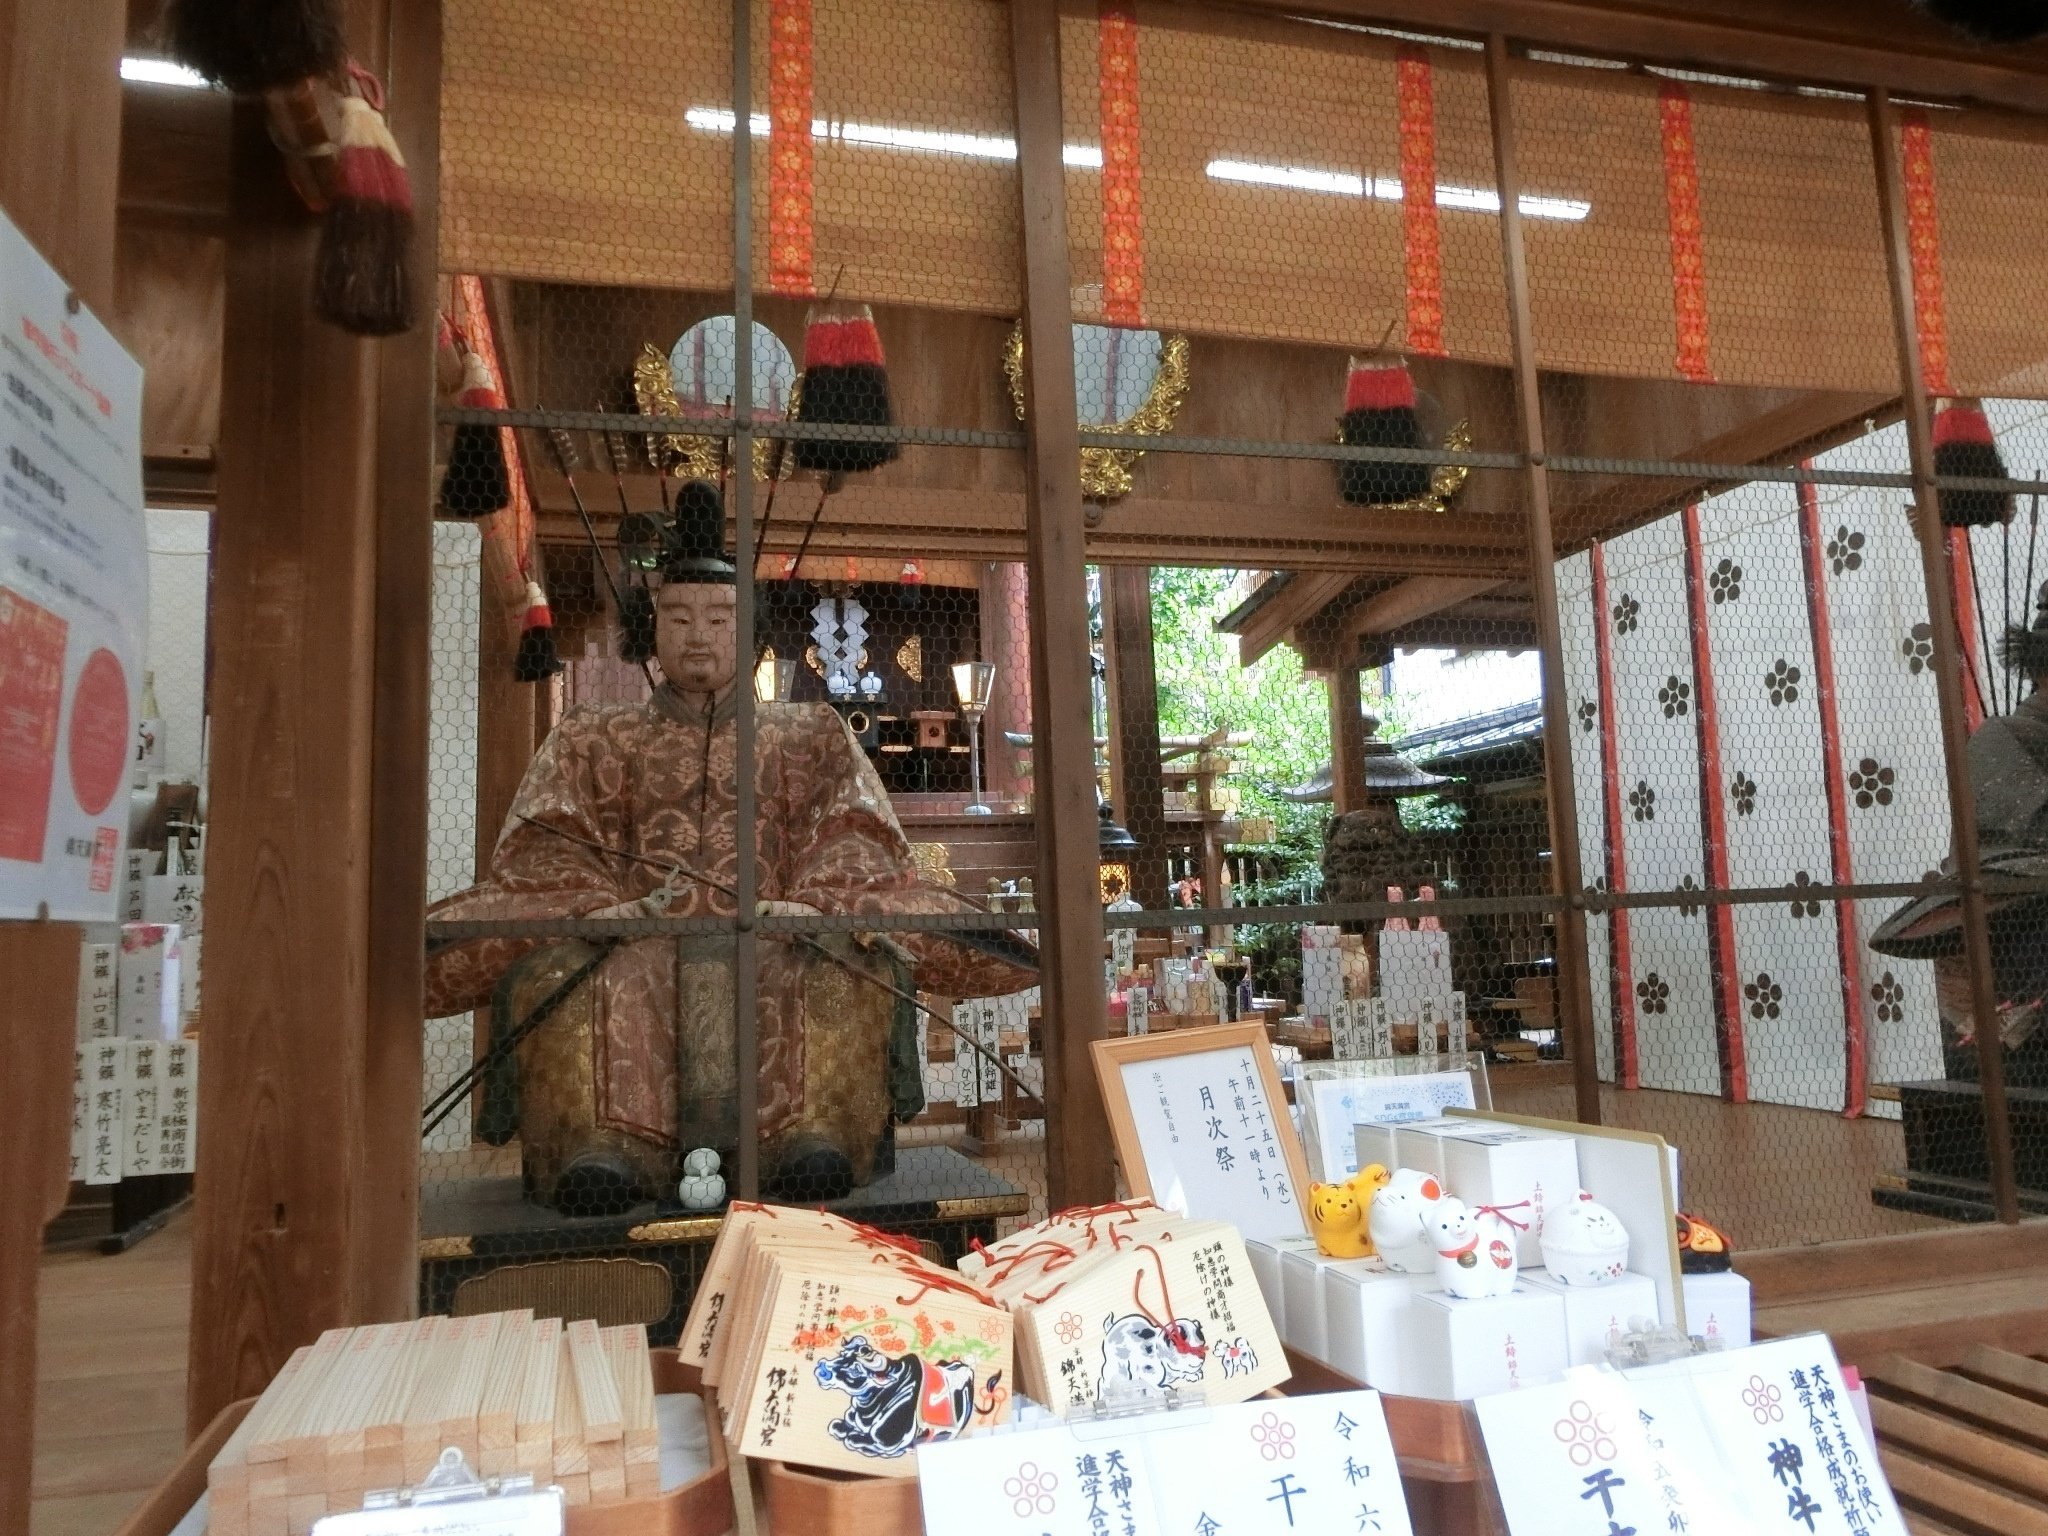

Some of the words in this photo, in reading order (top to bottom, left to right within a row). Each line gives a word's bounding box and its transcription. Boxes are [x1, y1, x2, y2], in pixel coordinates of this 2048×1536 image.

[132, 1088, 153, 1171] やまだしや
[170, 1087, 190, 1170] 新京極商店街
[1198, 1085, 1236, 1172] 月次祭
[1228, 1077, 1270, 1201] 午前十一時より
[1192, 1250, 1221, 1322] 厄除けの神様
[1212, 1240, 1234, 1288] 頭の神様
[1333, 1410, 1382, 1533] 令和六
[1767, 1437, 1823, 1535] 神牛
[1809, 1364, 1883, 1525] 天神さまのお使い
[1075, 1453, 1110, 1536] 進学合
